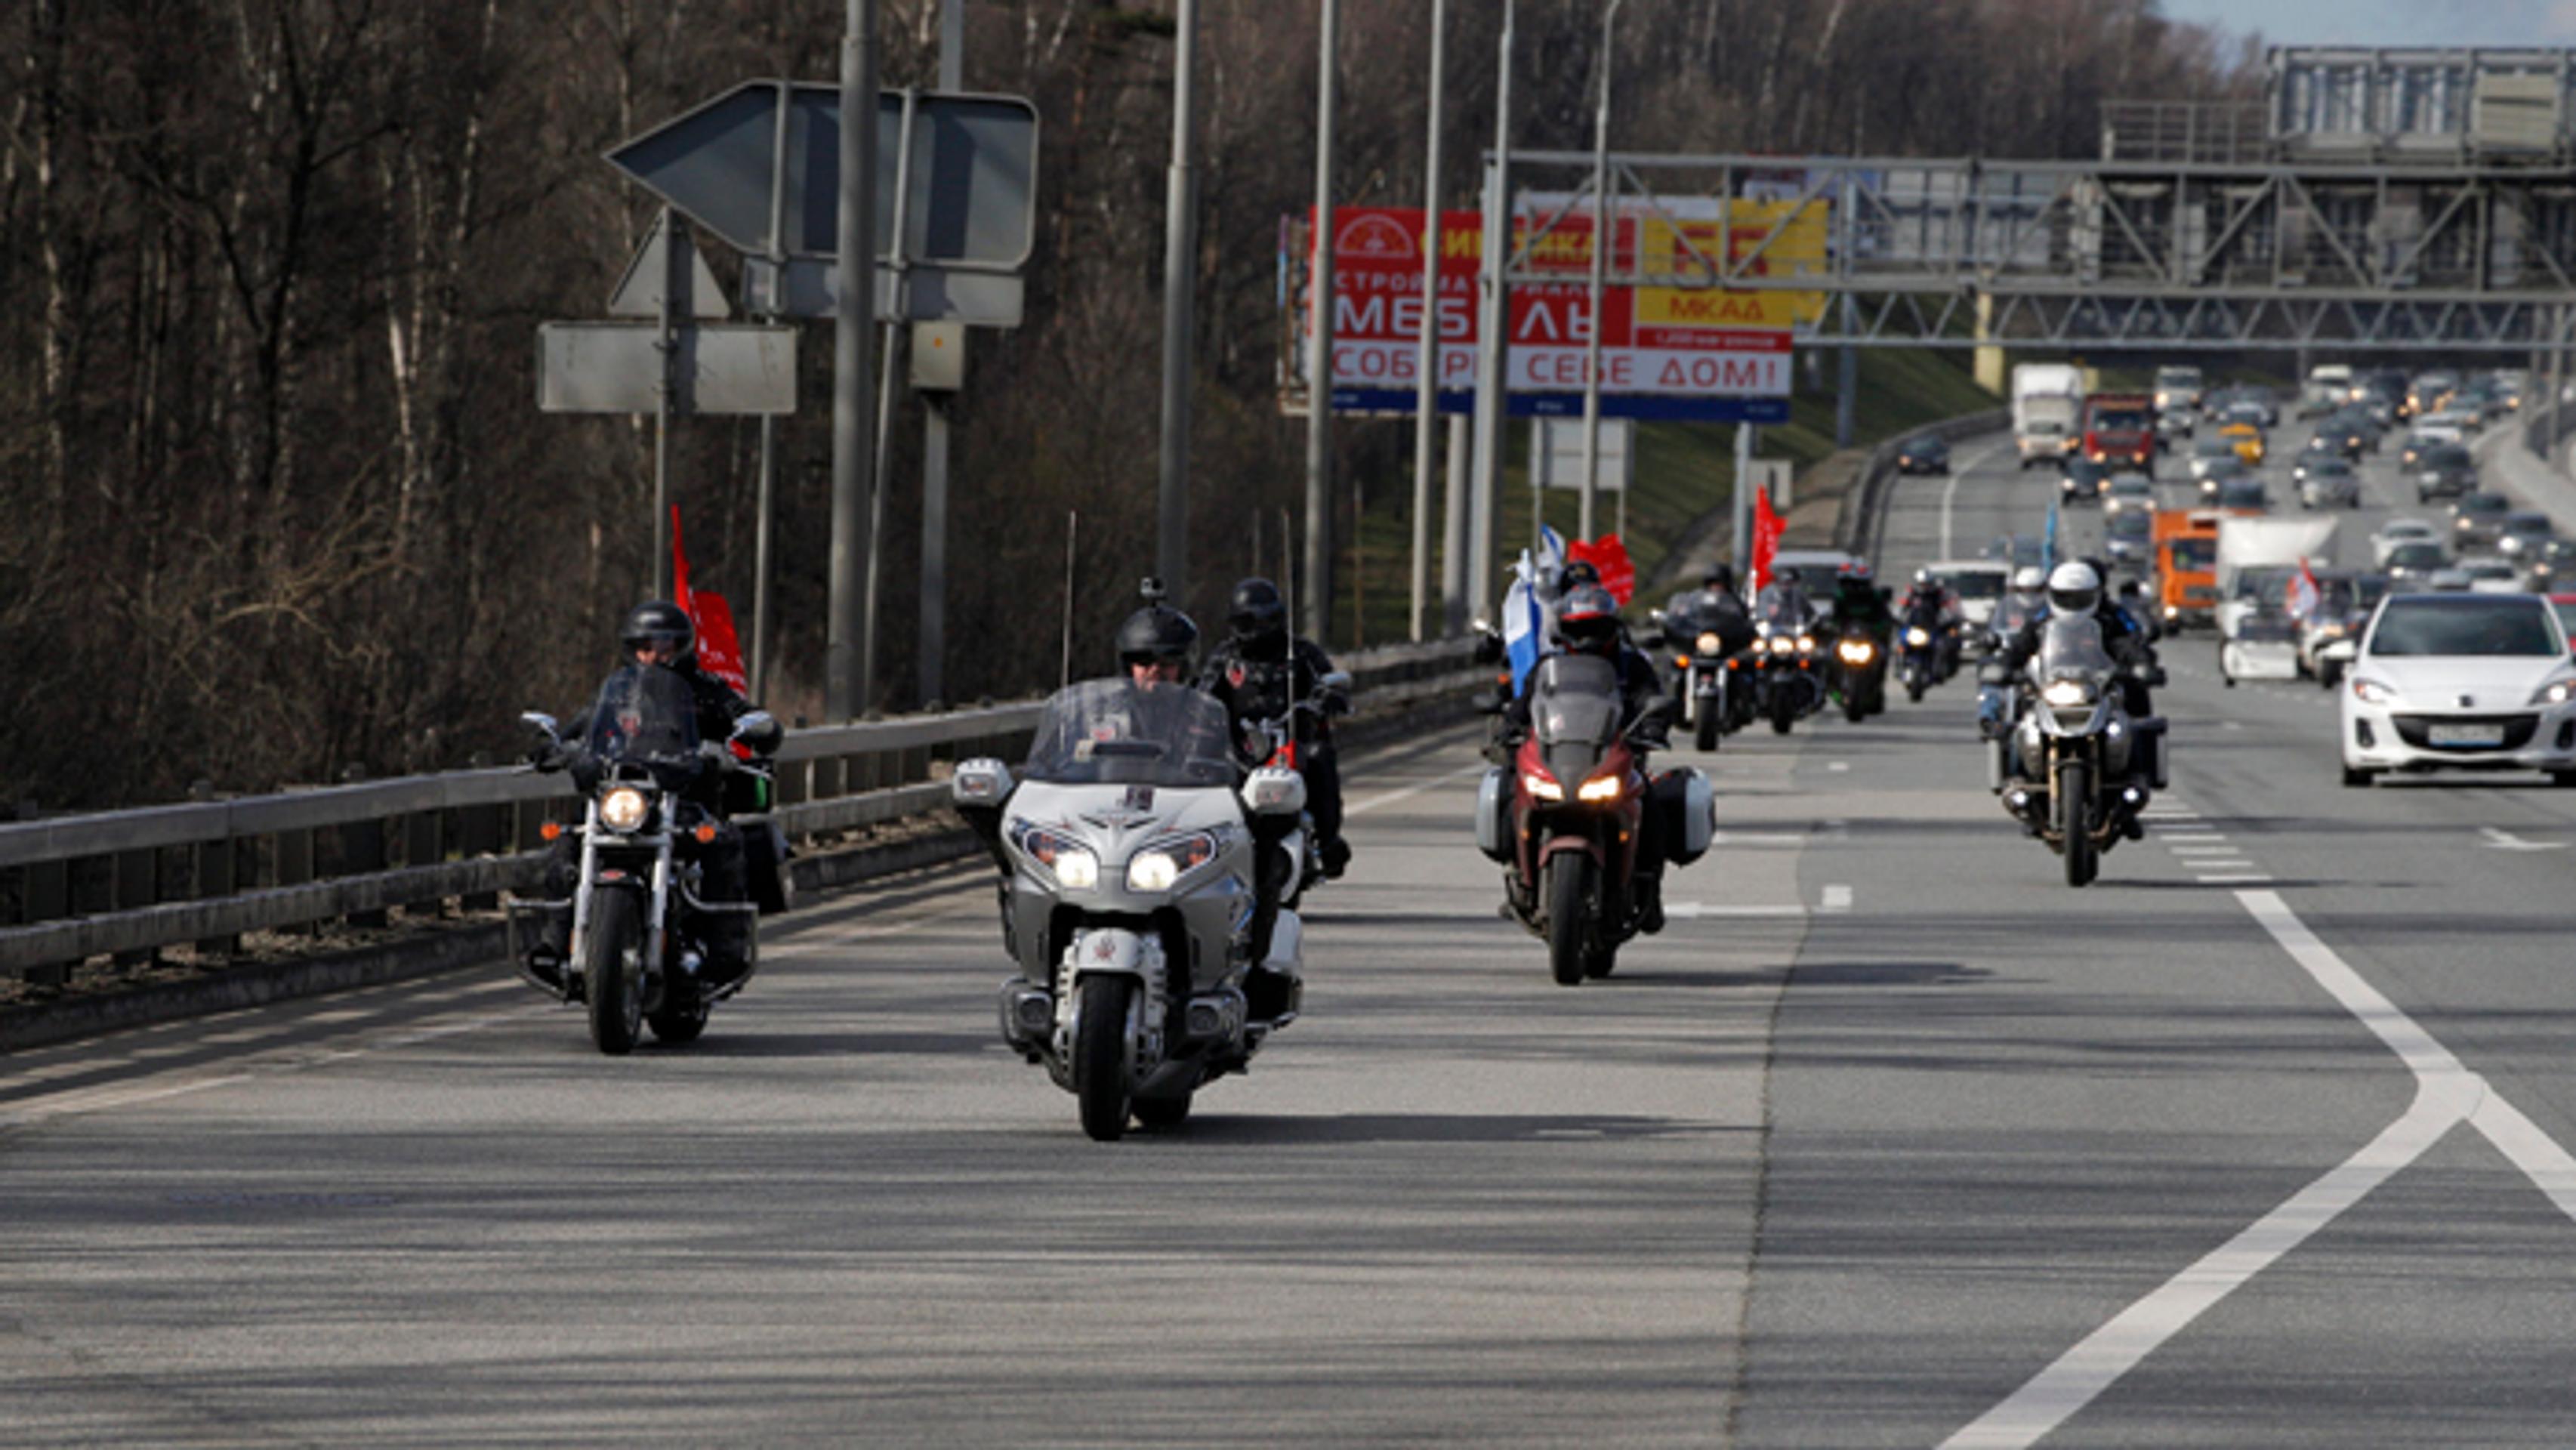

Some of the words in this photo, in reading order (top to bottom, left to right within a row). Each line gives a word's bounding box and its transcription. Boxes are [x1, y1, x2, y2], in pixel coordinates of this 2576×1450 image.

[1334, 295, 1597, 339] МЕБЛЬ
[1670, 297, 1764, 320] МКАД
[1331, 347, 1489, 379] СОБР
[1527, 353, 1632, 385] СЕБЕ
[1658, 356, 1776, 387] ДОМ!
